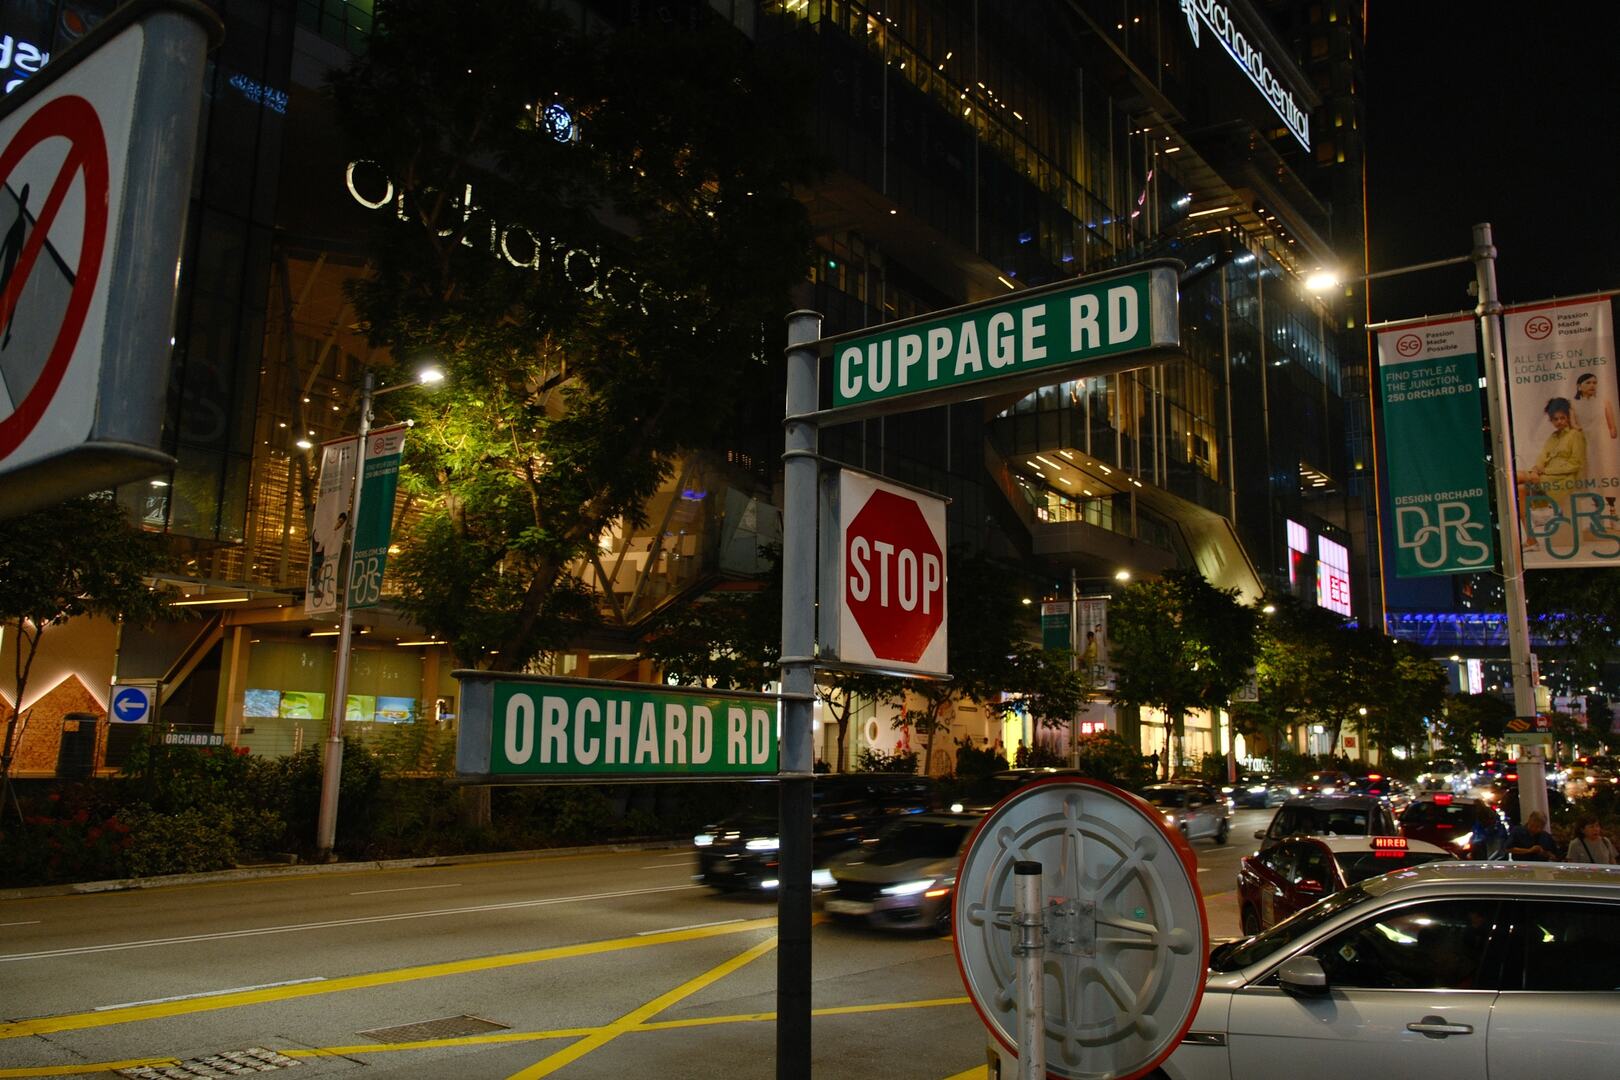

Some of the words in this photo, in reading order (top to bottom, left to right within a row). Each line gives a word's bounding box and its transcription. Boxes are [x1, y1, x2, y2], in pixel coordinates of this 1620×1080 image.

[1529, 322, 1549, 334] SG
[1557, 311, 1588, 321] Passion
[1558, 320, 1580, 329] Made
[1558, 326, 1593, 336] Possible
[839, 303, 1047, 399] CUPPAGE
[1069, 285, 1139, 353] RD
[1400, 340, 1419, 352] SG
[1426, 330, 1455, 339] Passion
[1426, 338, 1447, 346] Made
[1427, 343, 1459, 353] Possible
[1514, 355, 1535, 364] ALL
[1537, 351, 1563, 363] EYES
[1567, 349, 1583, 359] ON
[1555, 362, 1576, 371] ALL
[1579, 357, 1607, 369] EYES
[1386, 371, 1410, 383] FIND
[1411, 366, 1442, 379] STYLE
[1444, 364, 1457, 374] AT
[1516, 376, 1531, 385] ON
[1387, 382, 1407, 392] THE
[1387, 393, 1406, 403] 250
[1406, 386, 1457, 401] ORCHARD
[1458, 383, 1473, 394] RD
[1525, 477, 1620, 492] RS.COM.SG
[1395, 493, 1432, 505] DESIGN
[1434, 487, 1483, 502] ORCHARD
[849, 535, 941, 616] STOP
[504, 692, 713, 766] ORCHARD
[727, 706, 771, 765] RD
[166, 733, 208, 745] ORCHARD
[210, 735, 222, 746] RD
[1376, 838, 1407, 848] HIRED
